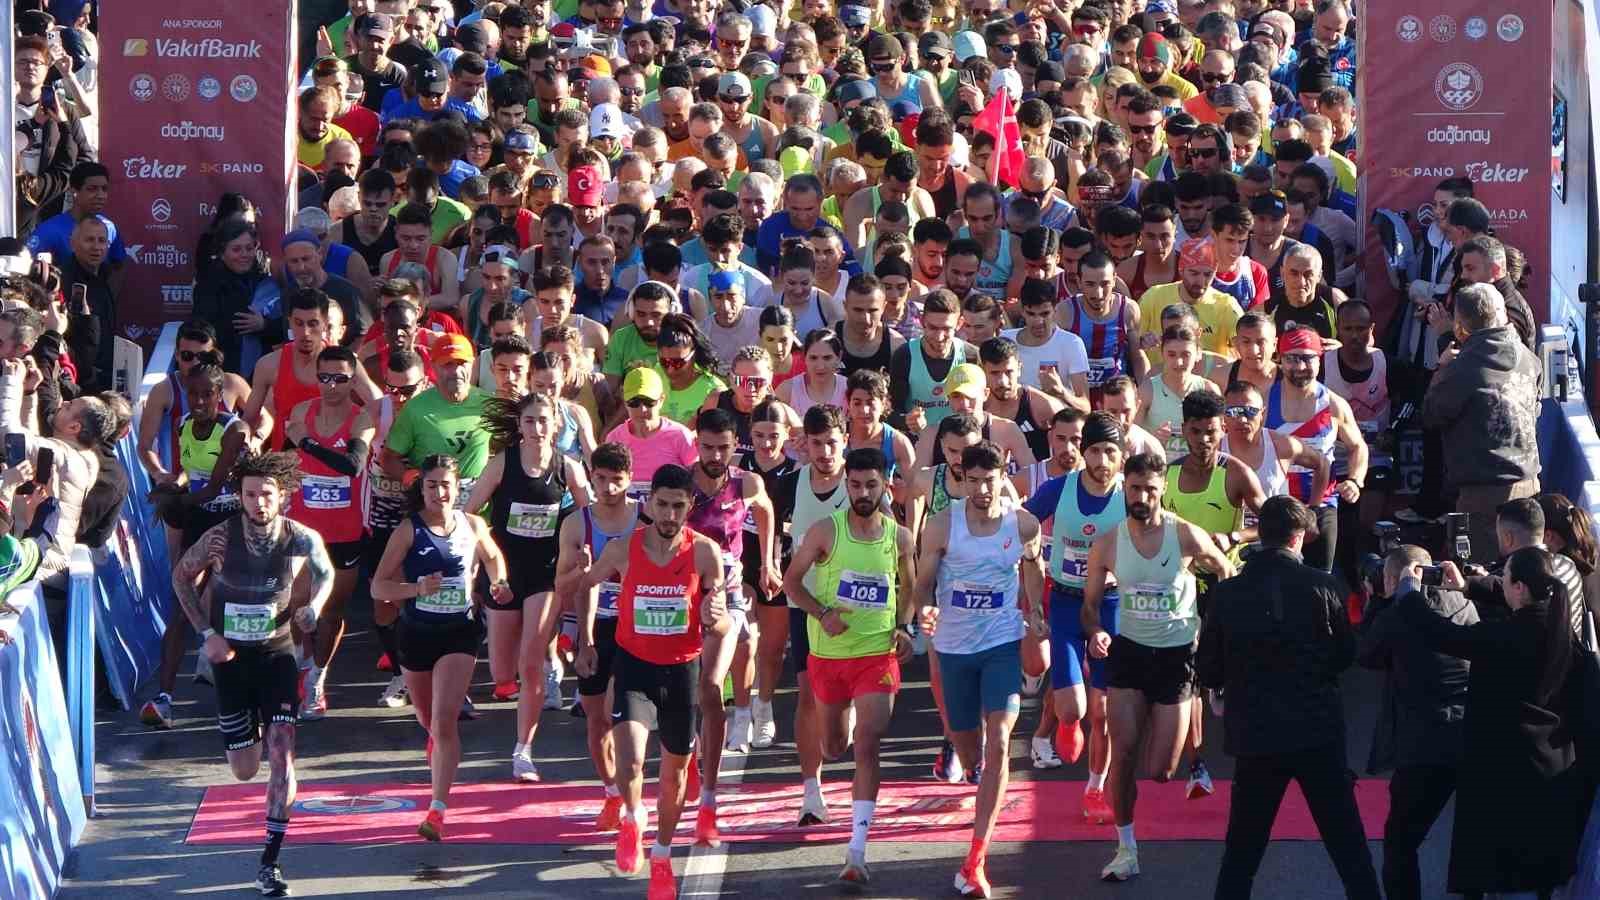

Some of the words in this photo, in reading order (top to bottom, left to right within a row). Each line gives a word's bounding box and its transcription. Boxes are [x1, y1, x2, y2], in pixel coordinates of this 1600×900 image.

[163, 19, 181, 28] ANA
[182, 19, 223, 29] SPONSOR
[155, 38, 262, 58] VakıfBank
[161, 121, 224, 141] doğanay
[1427, 125, 1491, 145] doğanay
[123, 156, 187, 178] Teker
[223, 163, 264, 173] PANO
[1414, 167, 1454, 177] PANO
[1465, 161, 1529, 184] Teker
[1488, 208, 1528, 219] MADA
[144, 250, 188, 268] magic
[311, 488, 341, 501] 263
[516, 515, 552, 529] 1427
[1074, 563, 1089, 576] 12
[636, 585, 688, 595] SPORTIVE
[850, 584, 878, 601] 108
[965, 594, 993, 609] 172
[1129, 597, 1170, 610] 1040
[231, 617, 270, 632] 1437
[644, 611, 677, 626] 1117
